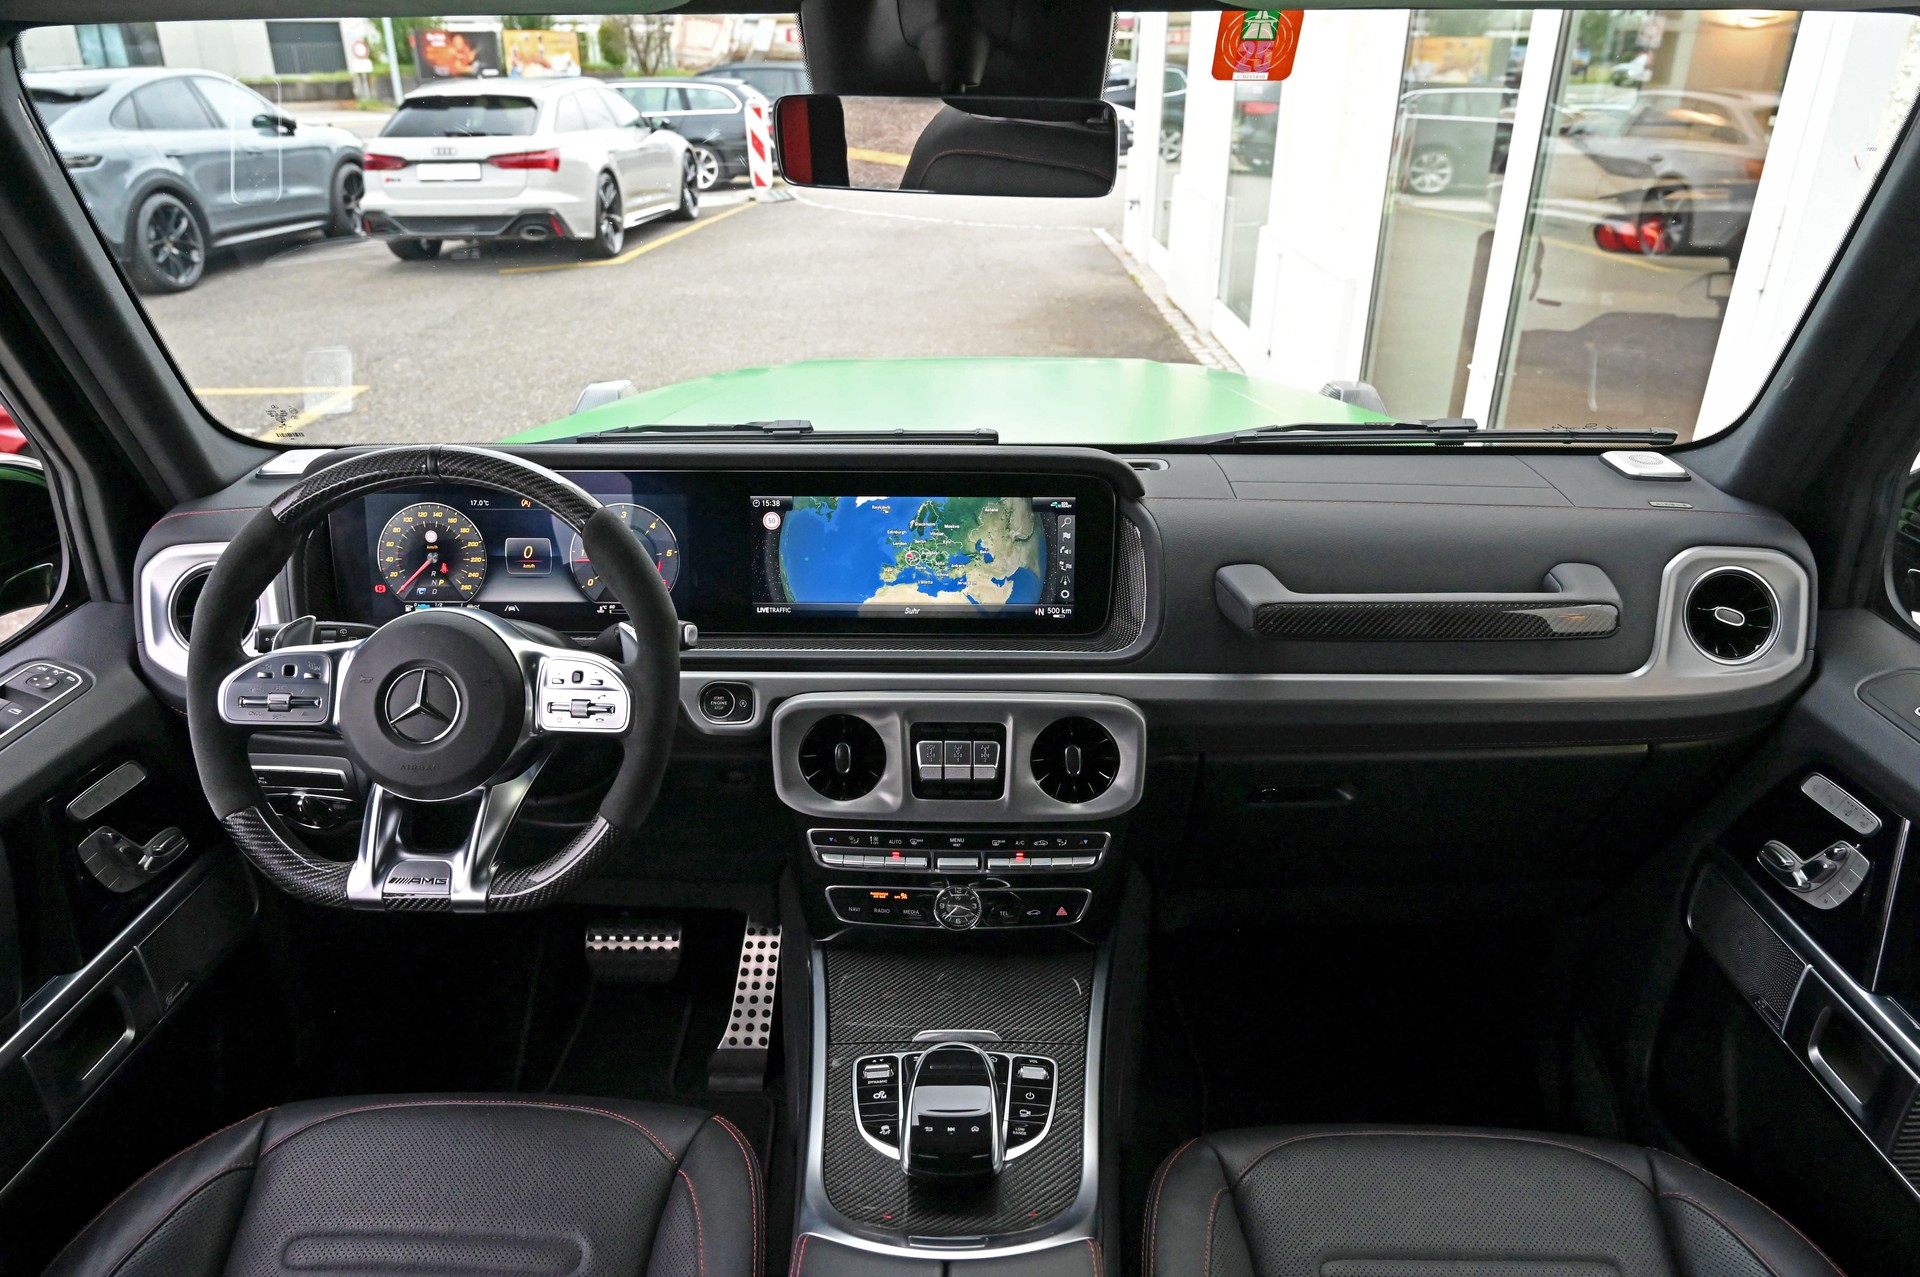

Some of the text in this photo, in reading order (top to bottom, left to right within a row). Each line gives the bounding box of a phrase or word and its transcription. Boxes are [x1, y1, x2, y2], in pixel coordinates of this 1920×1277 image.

[1235, 41, 1274, 72] 25
[523, 545, 533, 559] 0
[666, 549, 673, 557] 5
[587, 578, 594, 586] 0
[904, 607, 921, 615] Suhr
[1038, 607, 1045, 616] N
[1061, 607, 1072, 615] km
